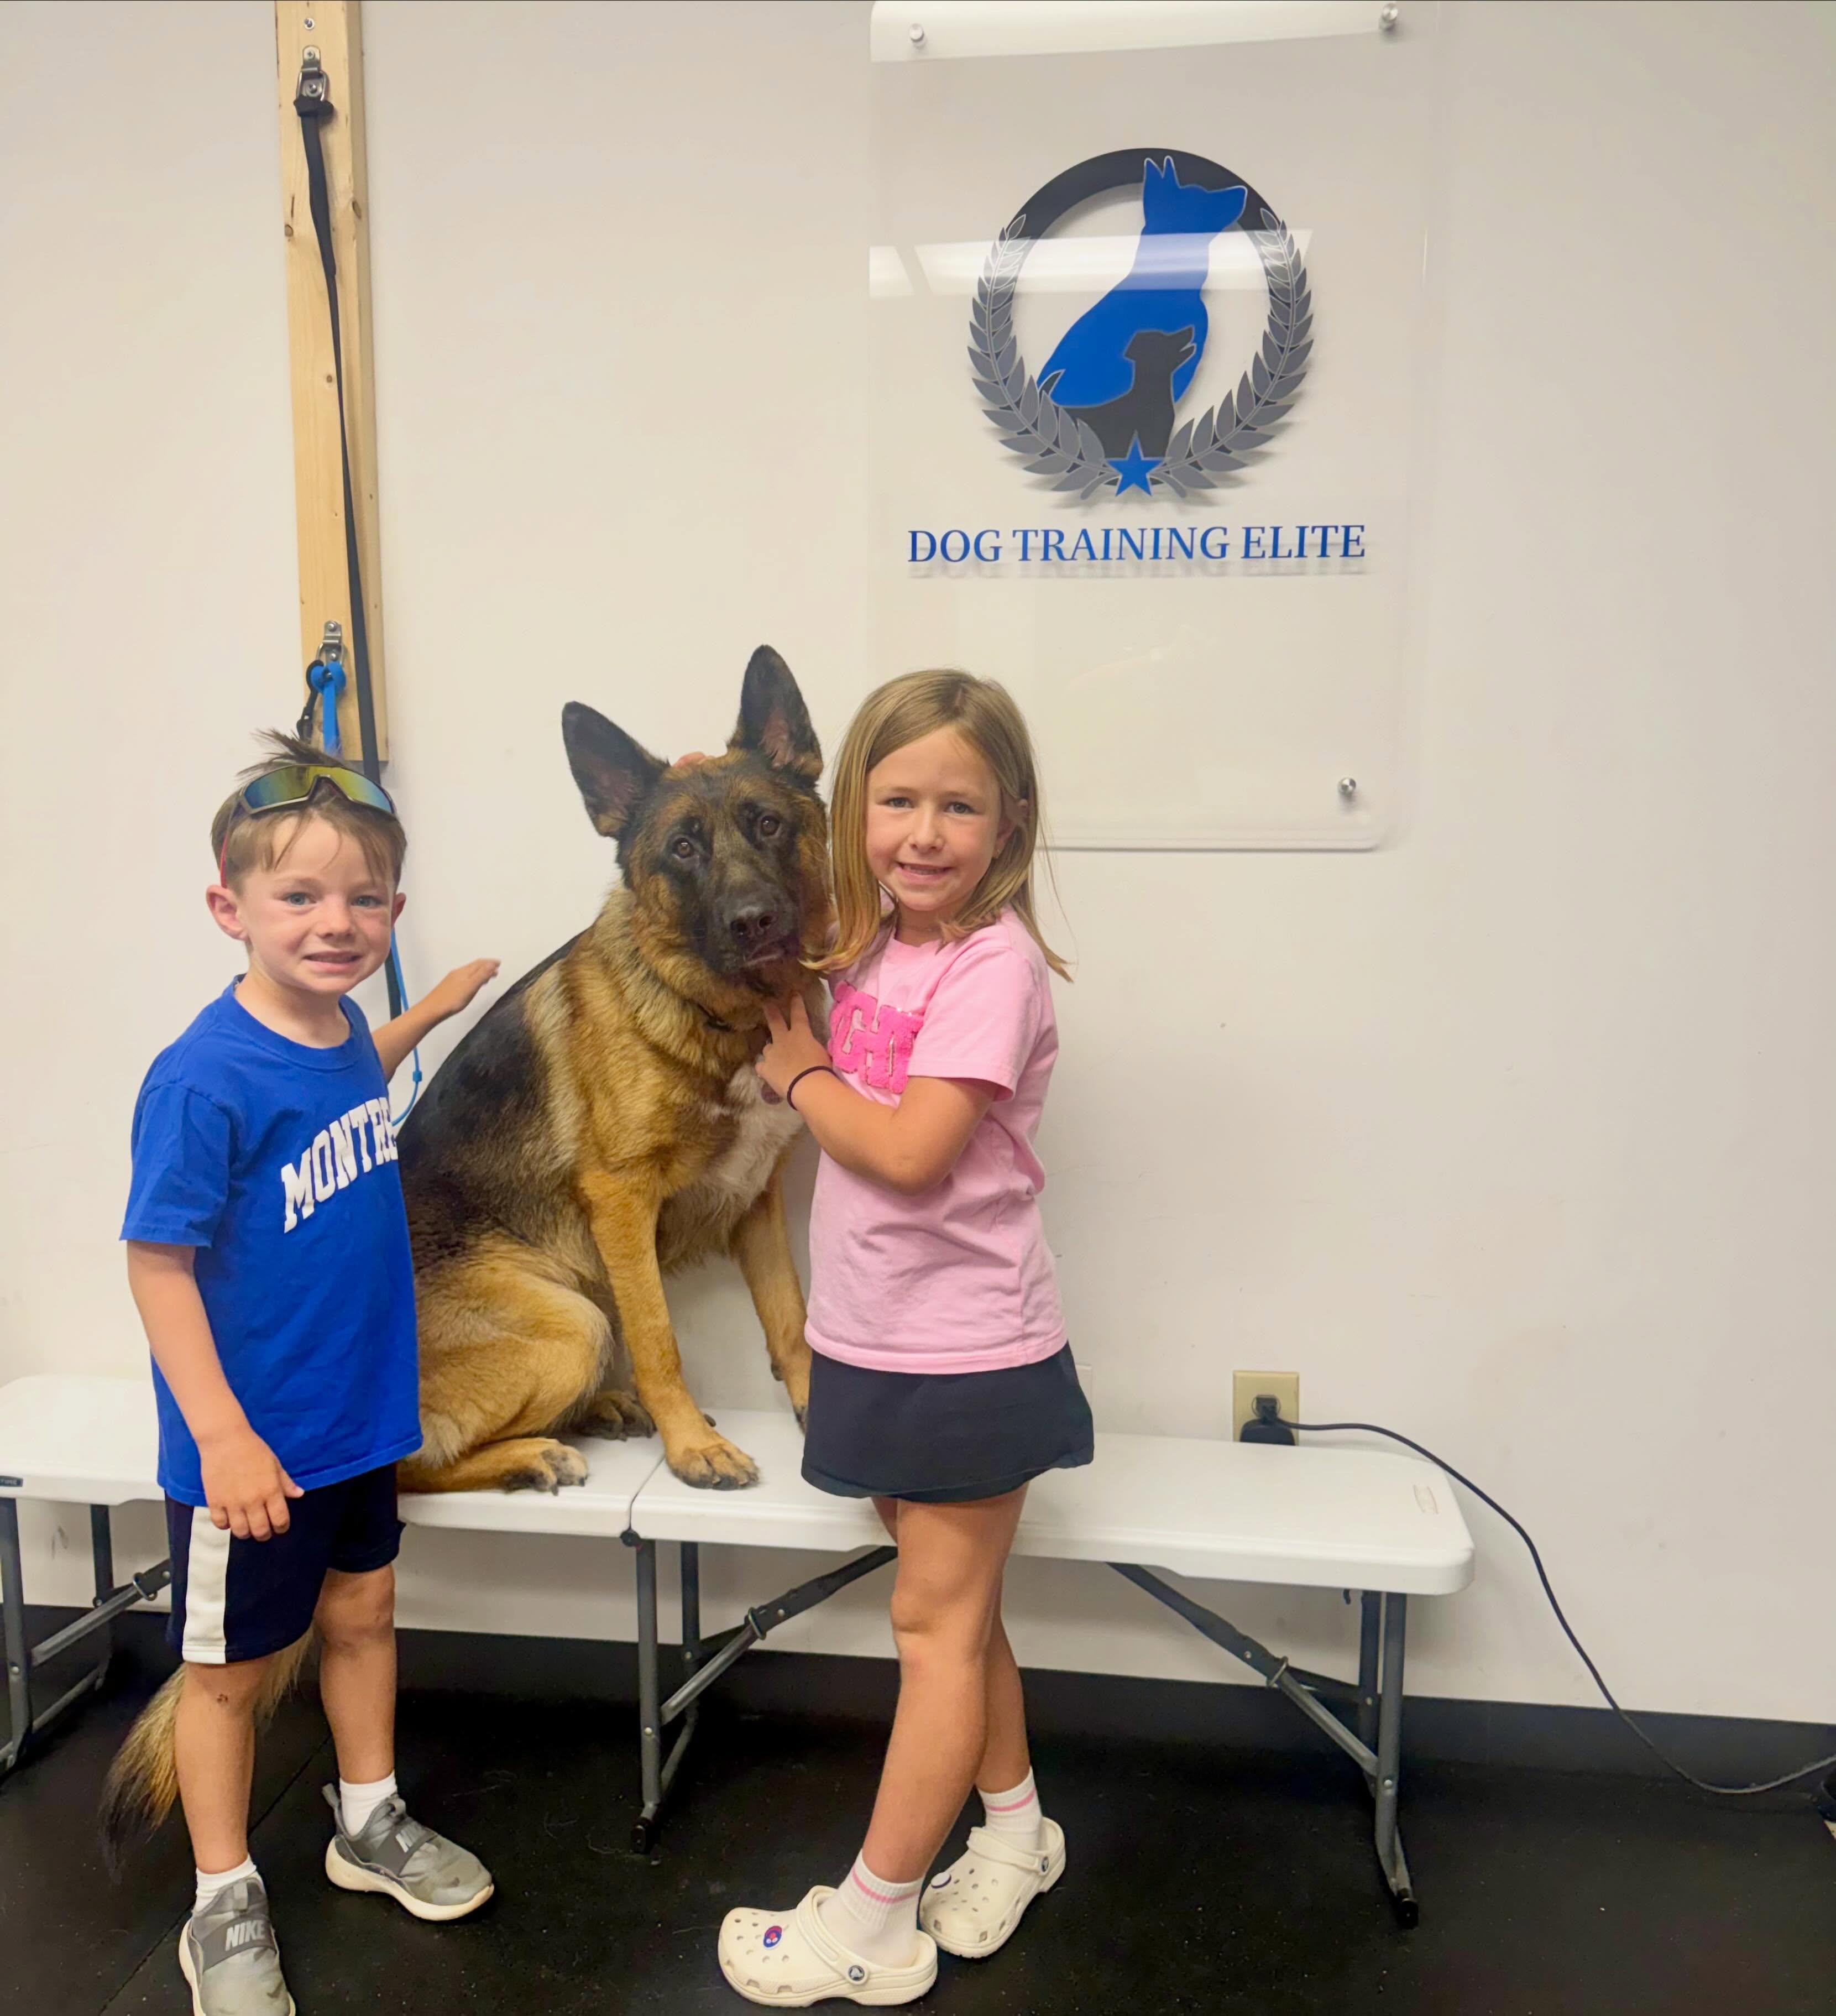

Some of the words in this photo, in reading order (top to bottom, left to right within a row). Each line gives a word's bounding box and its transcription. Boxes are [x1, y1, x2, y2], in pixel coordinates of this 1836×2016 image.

[907, 529, 1003, 563] DOG
[1012, 526, 1230, 562] TRAINING
[1241, 524, 1366, 559] ELITE
[225, 1919, 266, 1951] NIKE
